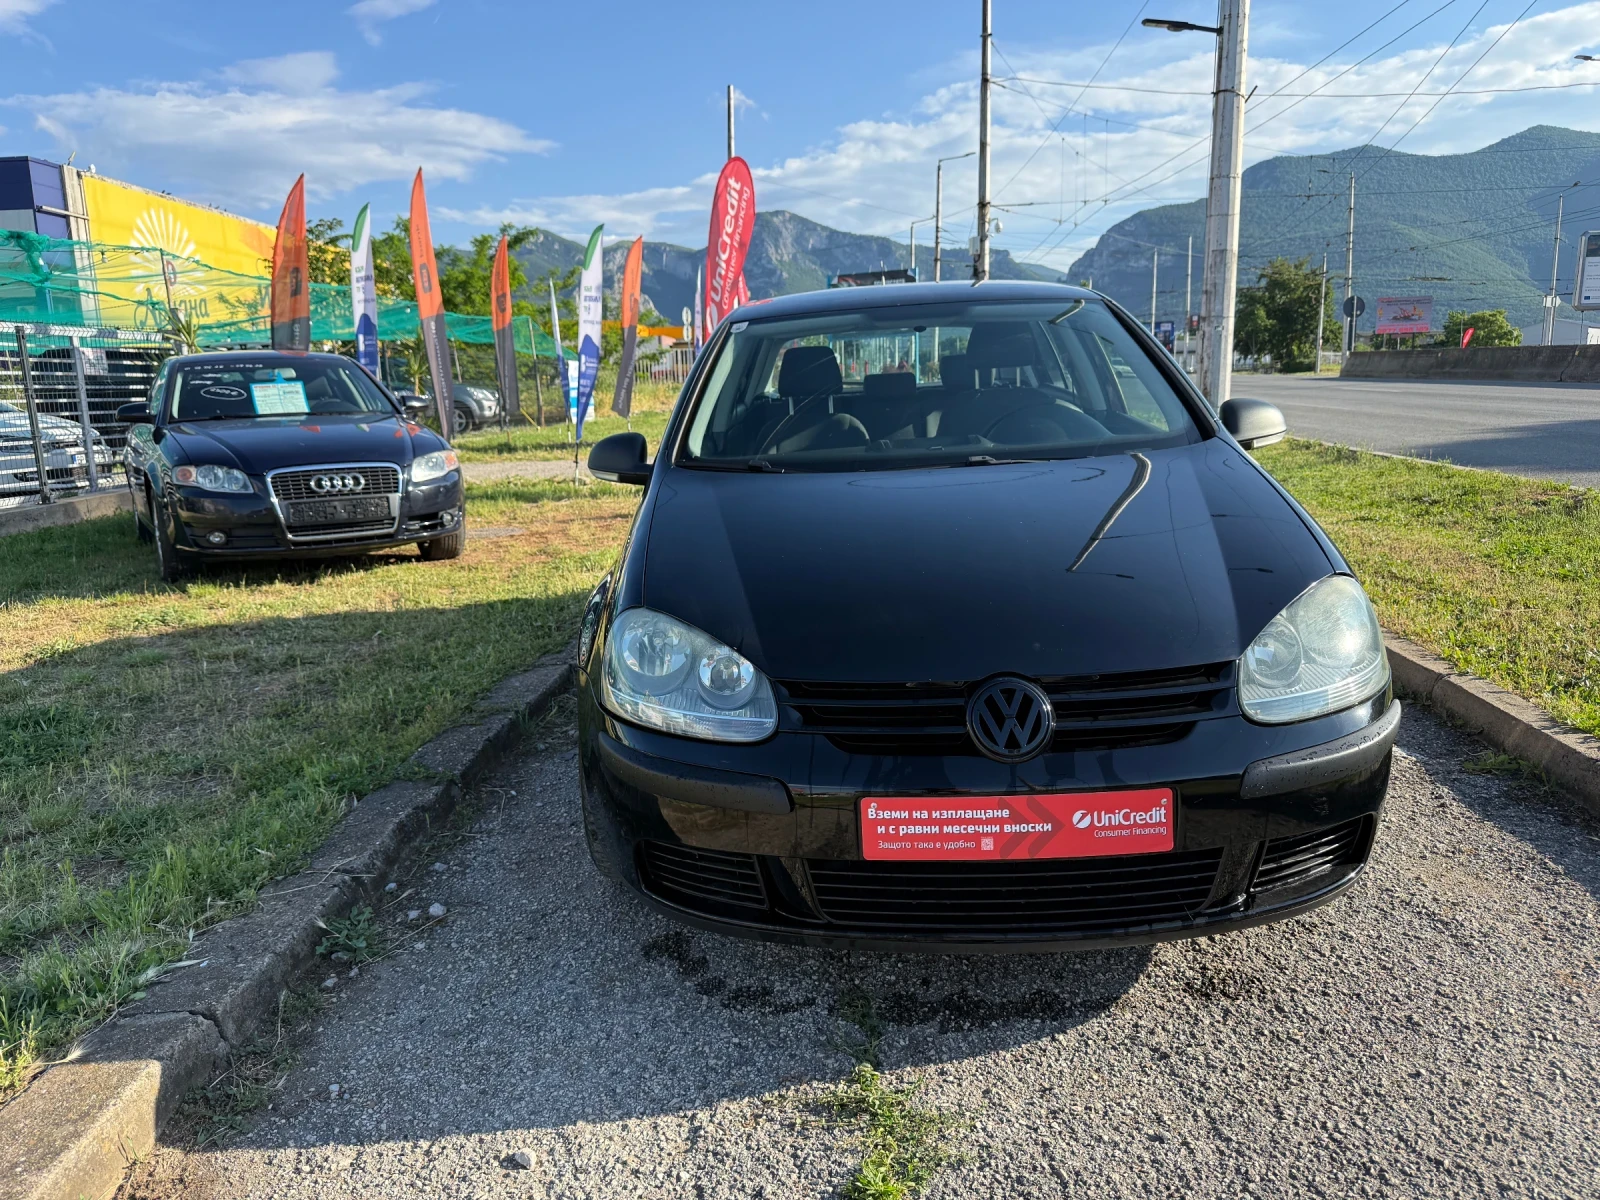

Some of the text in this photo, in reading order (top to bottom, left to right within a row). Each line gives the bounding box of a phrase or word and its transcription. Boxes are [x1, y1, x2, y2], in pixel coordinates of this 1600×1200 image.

[734, 188, 750, 248] Financing
[711, 177, 741, 302] UniCredit
[868, 808, 1010, 820] Вземи на изплащане
[1093, 806, 1167, 827] UniCredit
[877, 822, 1052, 836] и с равни месечни вноски
[1094, 826, 1167, 838] Consumer Financing
[877, 840, 976, 850] Защото така е удобно
